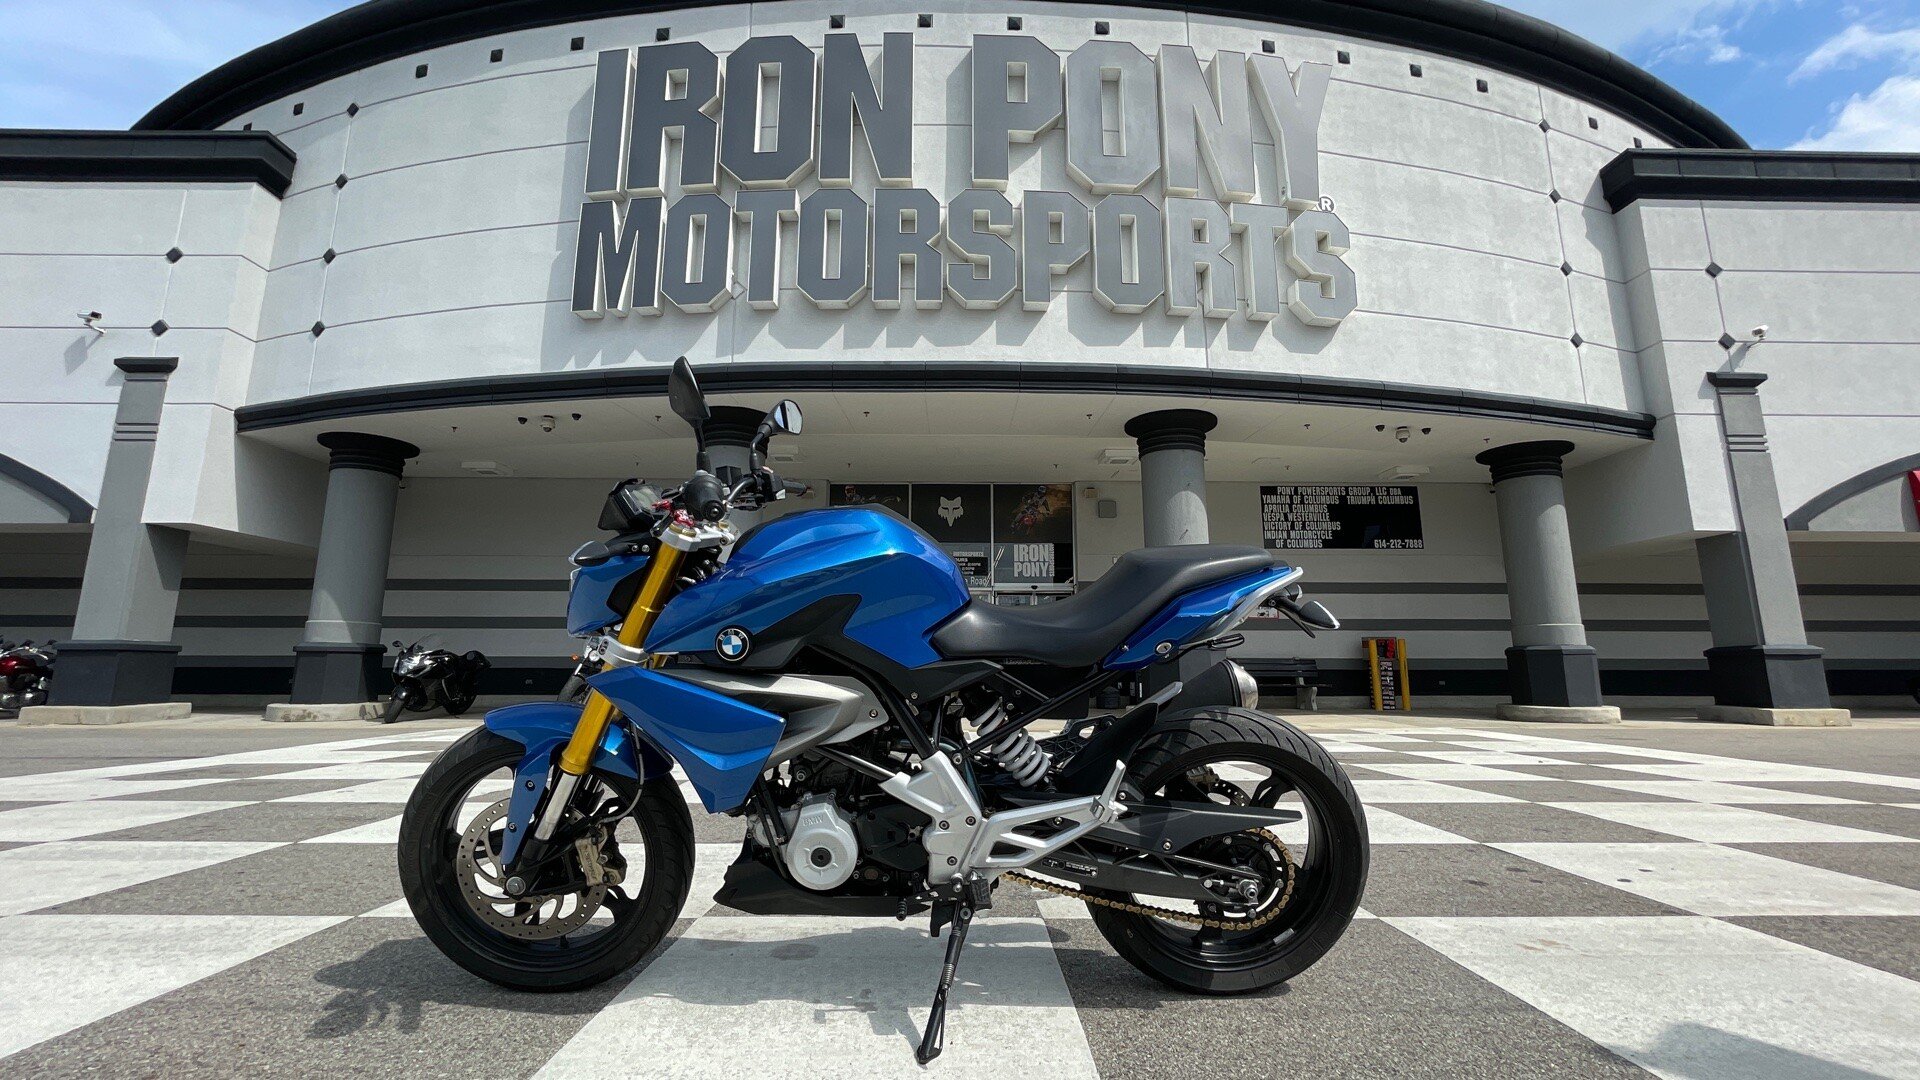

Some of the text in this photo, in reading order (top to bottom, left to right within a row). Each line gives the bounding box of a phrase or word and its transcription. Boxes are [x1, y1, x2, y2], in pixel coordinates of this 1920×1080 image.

[584, 32, 1333, 211] IRON PONY
[570, 188, 1358, 327] MOTORSPORTS
[1277, 486, 1402, 496] PONY POWERSPORTS GROUP, LLC DBA
[1262, 495, 1340, 505] YAMAHA OF COLUMBUS
[1346, 495, 1414, 505] TRIUMPH COLUMBUS
[1264, 504, 1328, 513] APRILIA COLUMBUS
[1262, 512, 1330, 522] VESPA WESTERVILLE
[1263, 521, 1341, 530] VICTORY OF COLUMBUS
[1264, 530, 1333, 539] INDIAN MOTORCYCLE
[1275, 539, 1323, 548] OF COLUMBUS
[1013, 543, 1049, 562] IRON
[1013, 561, 1049, 578] PONY
[717, 628, 746, 641] BMW
